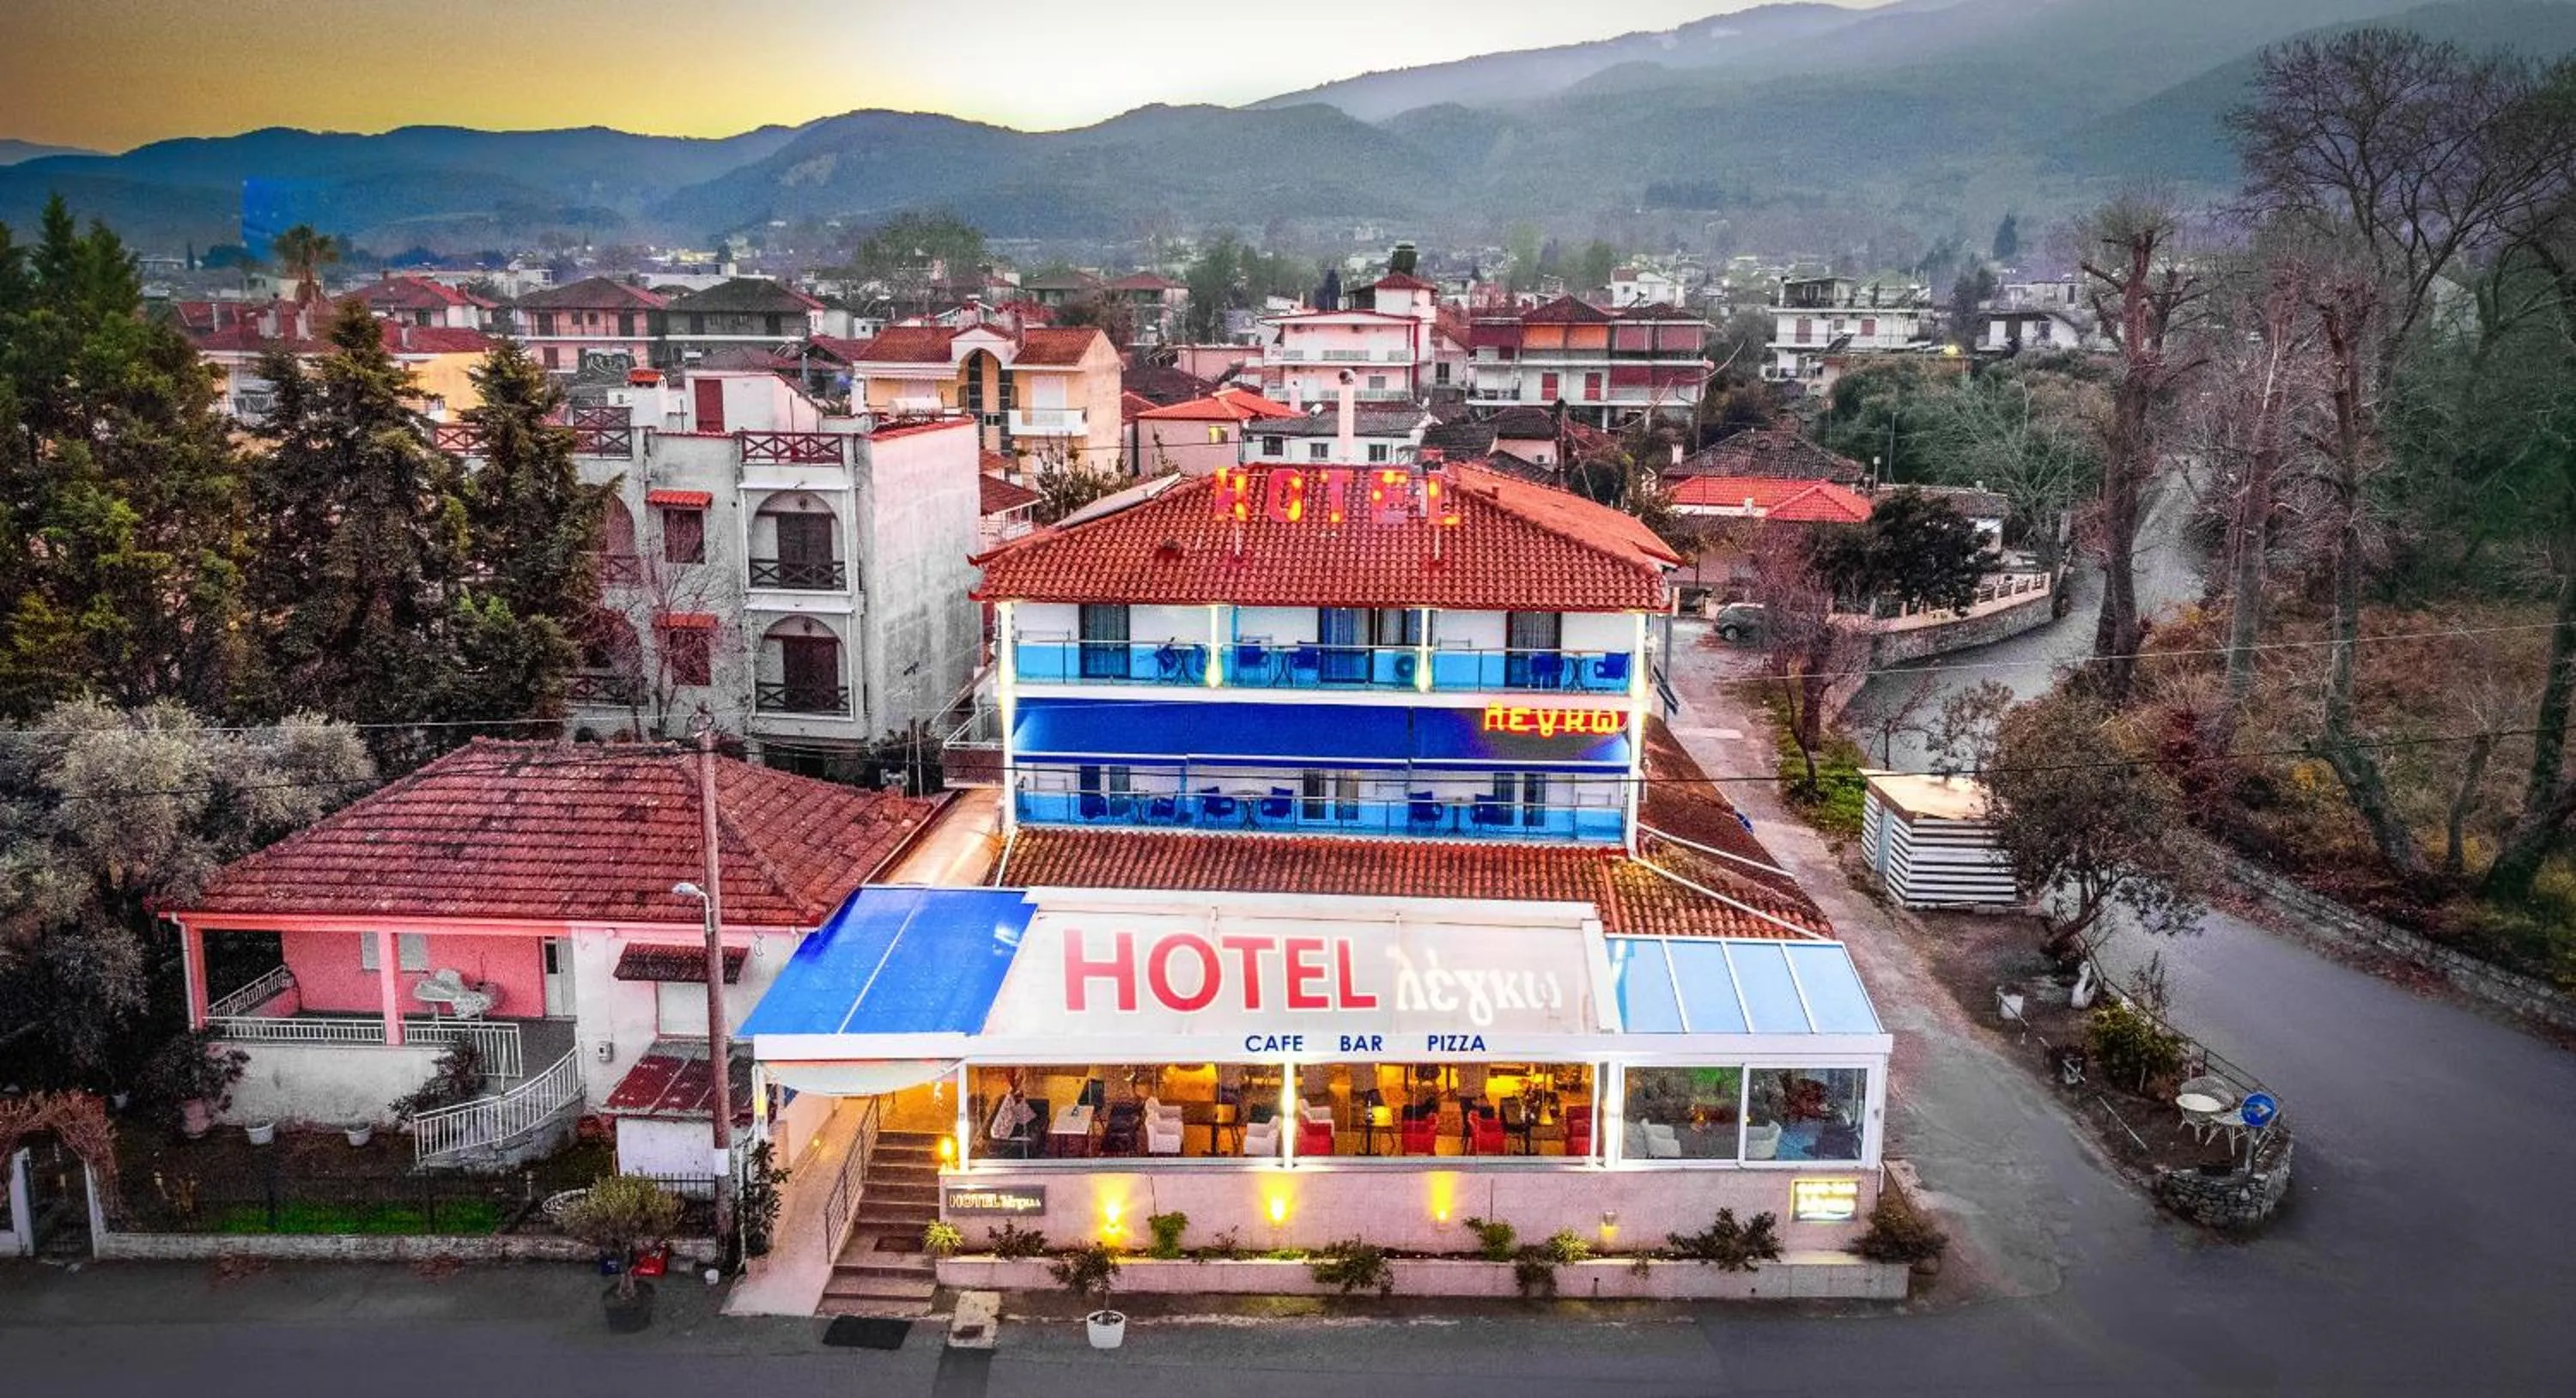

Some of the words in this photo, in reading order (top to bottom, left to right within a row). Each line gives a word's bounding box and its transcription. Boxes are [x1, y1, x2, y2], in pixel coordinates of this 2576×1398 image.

[1214, 468, 1460, 524] HOTEL
[1064, 928, 1377, 1012] HOTEL
[1244, 1034, 1304, 1053] CAFE
[1340, 1034, 1383, 1053] BAR
[1427, 1034, 1486, 1053] PIZZA
[949, 1194, 1000, 1209] HOTEL
